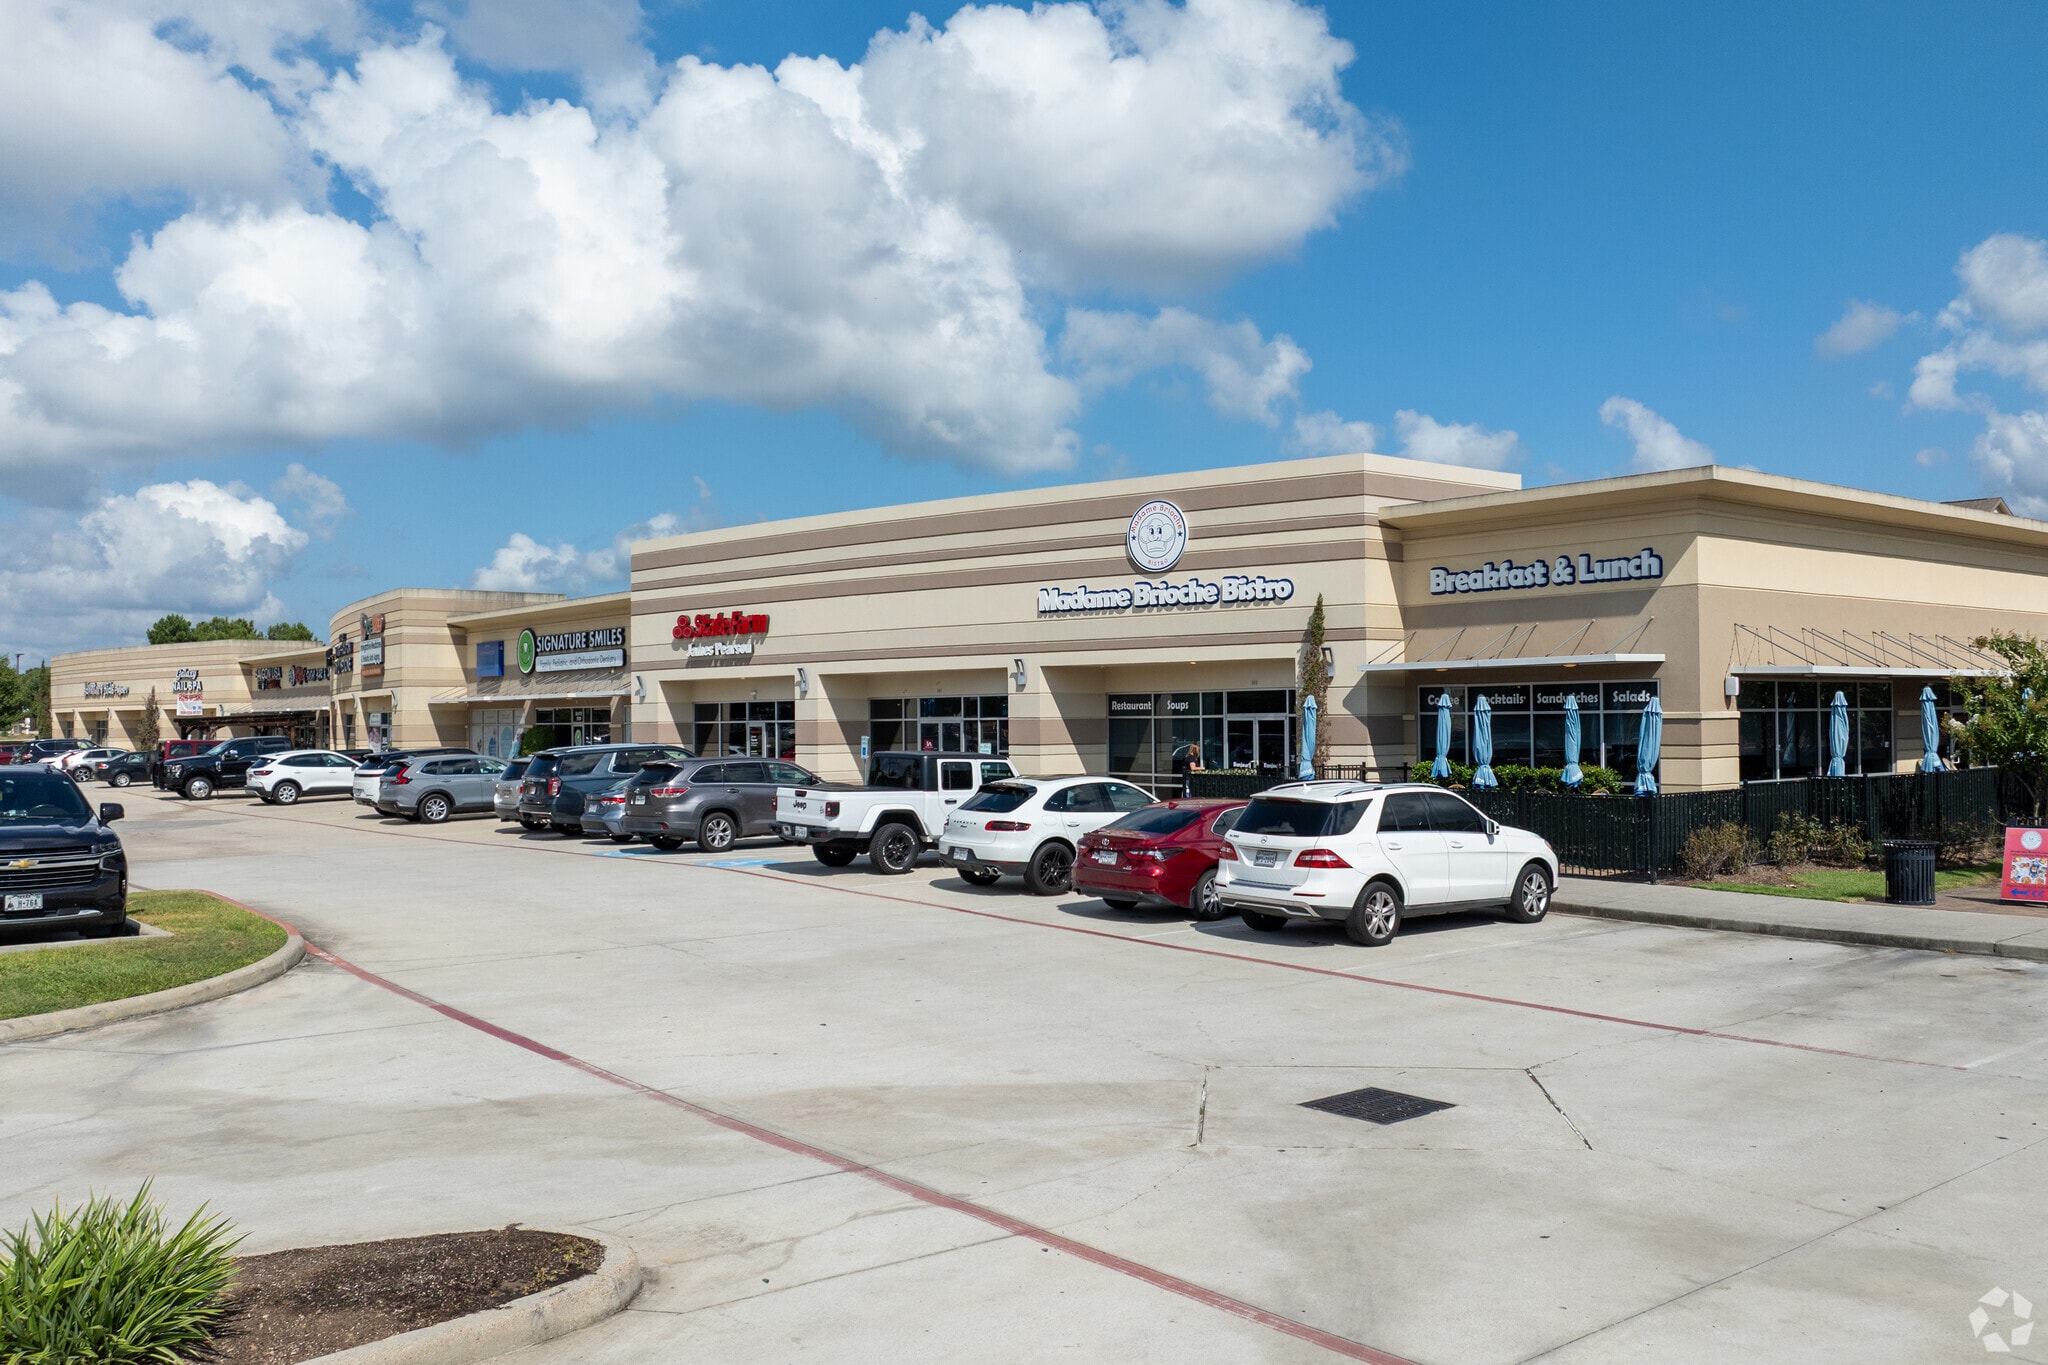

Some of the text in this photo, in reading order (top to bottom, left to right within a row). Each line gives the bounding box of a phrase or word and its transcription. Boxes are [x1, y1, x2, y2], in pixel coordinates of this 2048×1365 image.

[1131, 504, 1183, 533] Madame Brioche
[1148, 558, 1169, 567] BISTRO
[1429, 547, 1663, 596] Breakfast & Lunch
[1039, 575, 1294, 613] Madame Brioche Bistro
[692, 610, 768, 637] State Farm
[536, 628, 624, 652] SIGNATURE SMILES
[687, 642, 753, 657] James Pearson
[600, 654, 617, 665] Dentistry
[172, 681, 203, 691] NAIL SPA
[1613, 690, 1651, 702] Salads
[1111, 701, 1152, 710] Restaurant
[1167, 700, 1189, 711] Soups
[793, 800, 807, 810] Jeep
